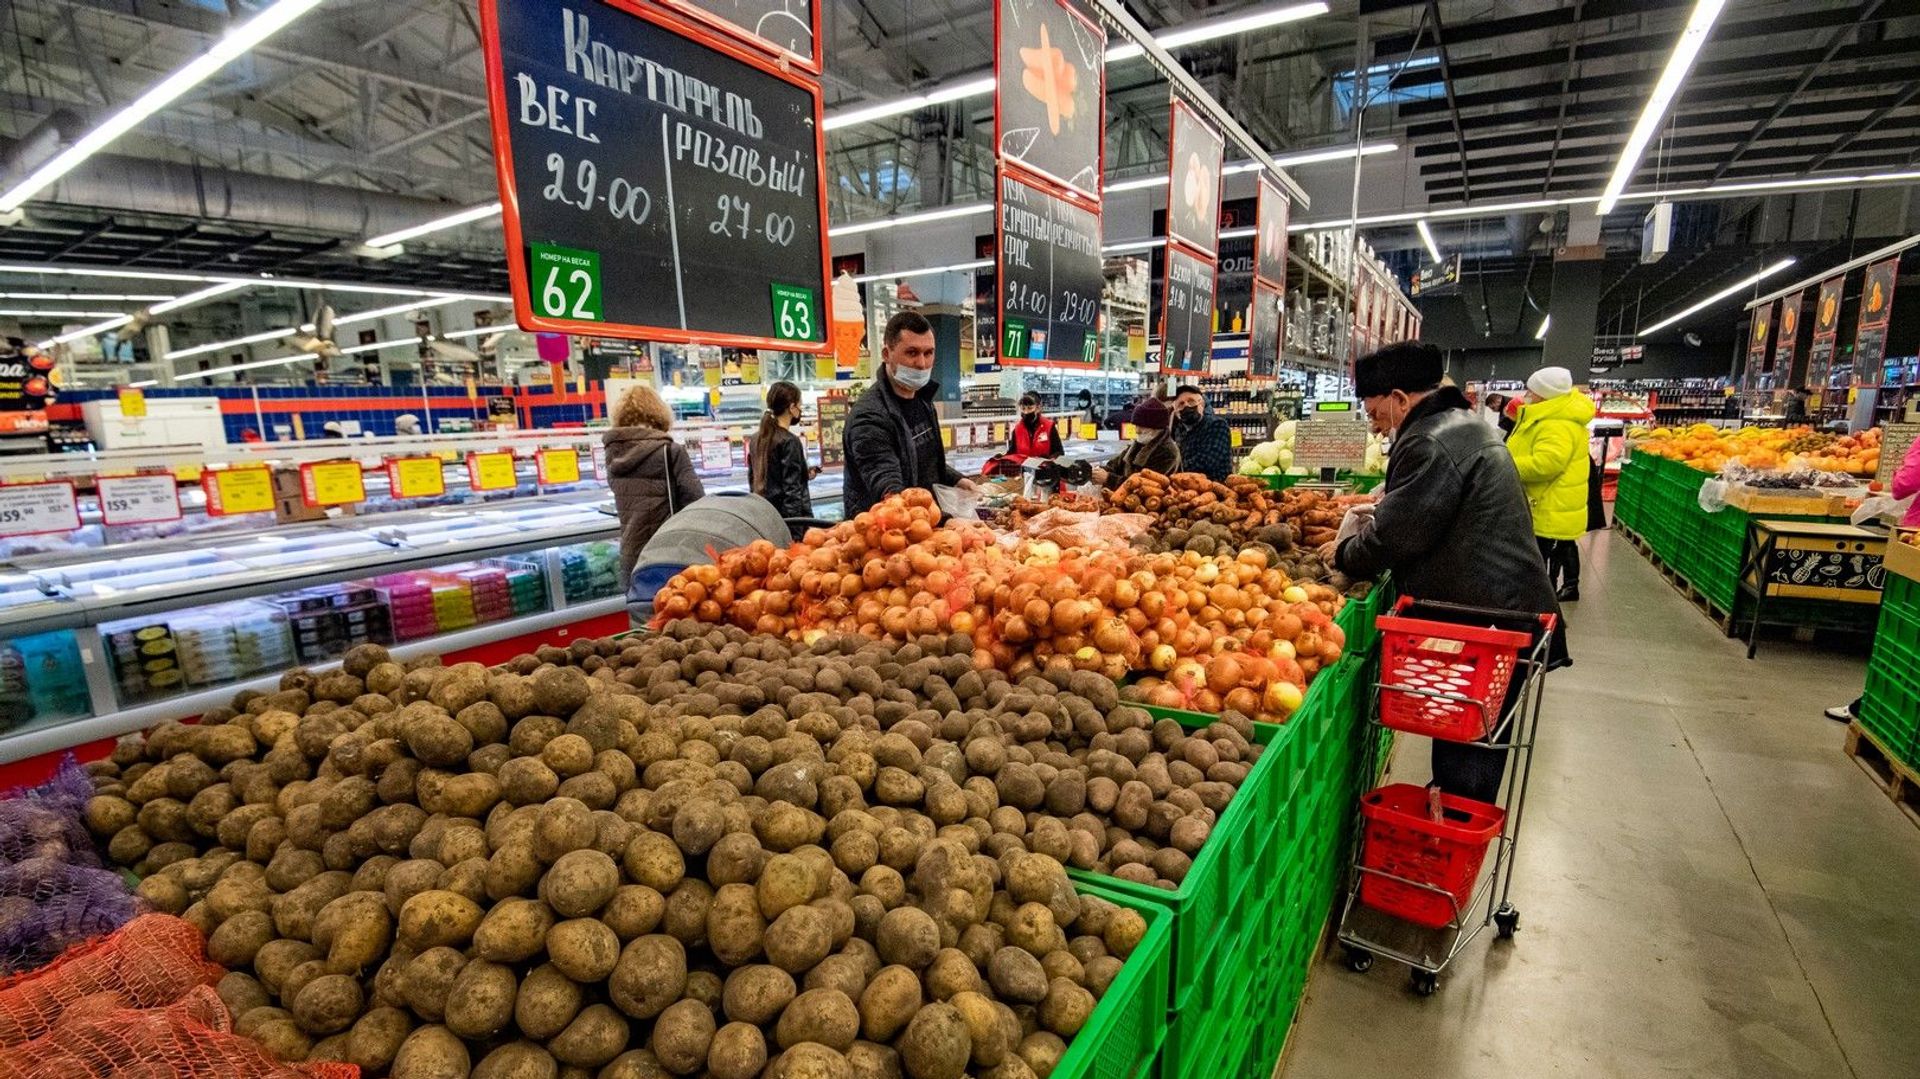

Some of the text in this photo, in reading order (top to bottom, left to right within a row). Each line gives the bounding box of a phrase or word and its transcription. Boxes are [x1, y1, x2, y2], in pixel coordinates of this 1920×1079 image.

[562, 8, 763, 139] КАРТОФЕЛЬ
[513, 72, 600, 143] ВЕС
[676, 121, 805, 197] РОЗОВЫЙ
[1002, 203, 1050, 243] ЕПЧАТЫЙ
[543, 266, 595, 320] 62
[780, 300, 810, 339] 63
[1008, 330, 1021, 357] 71
[1084, 340, 1096, 362] 70
